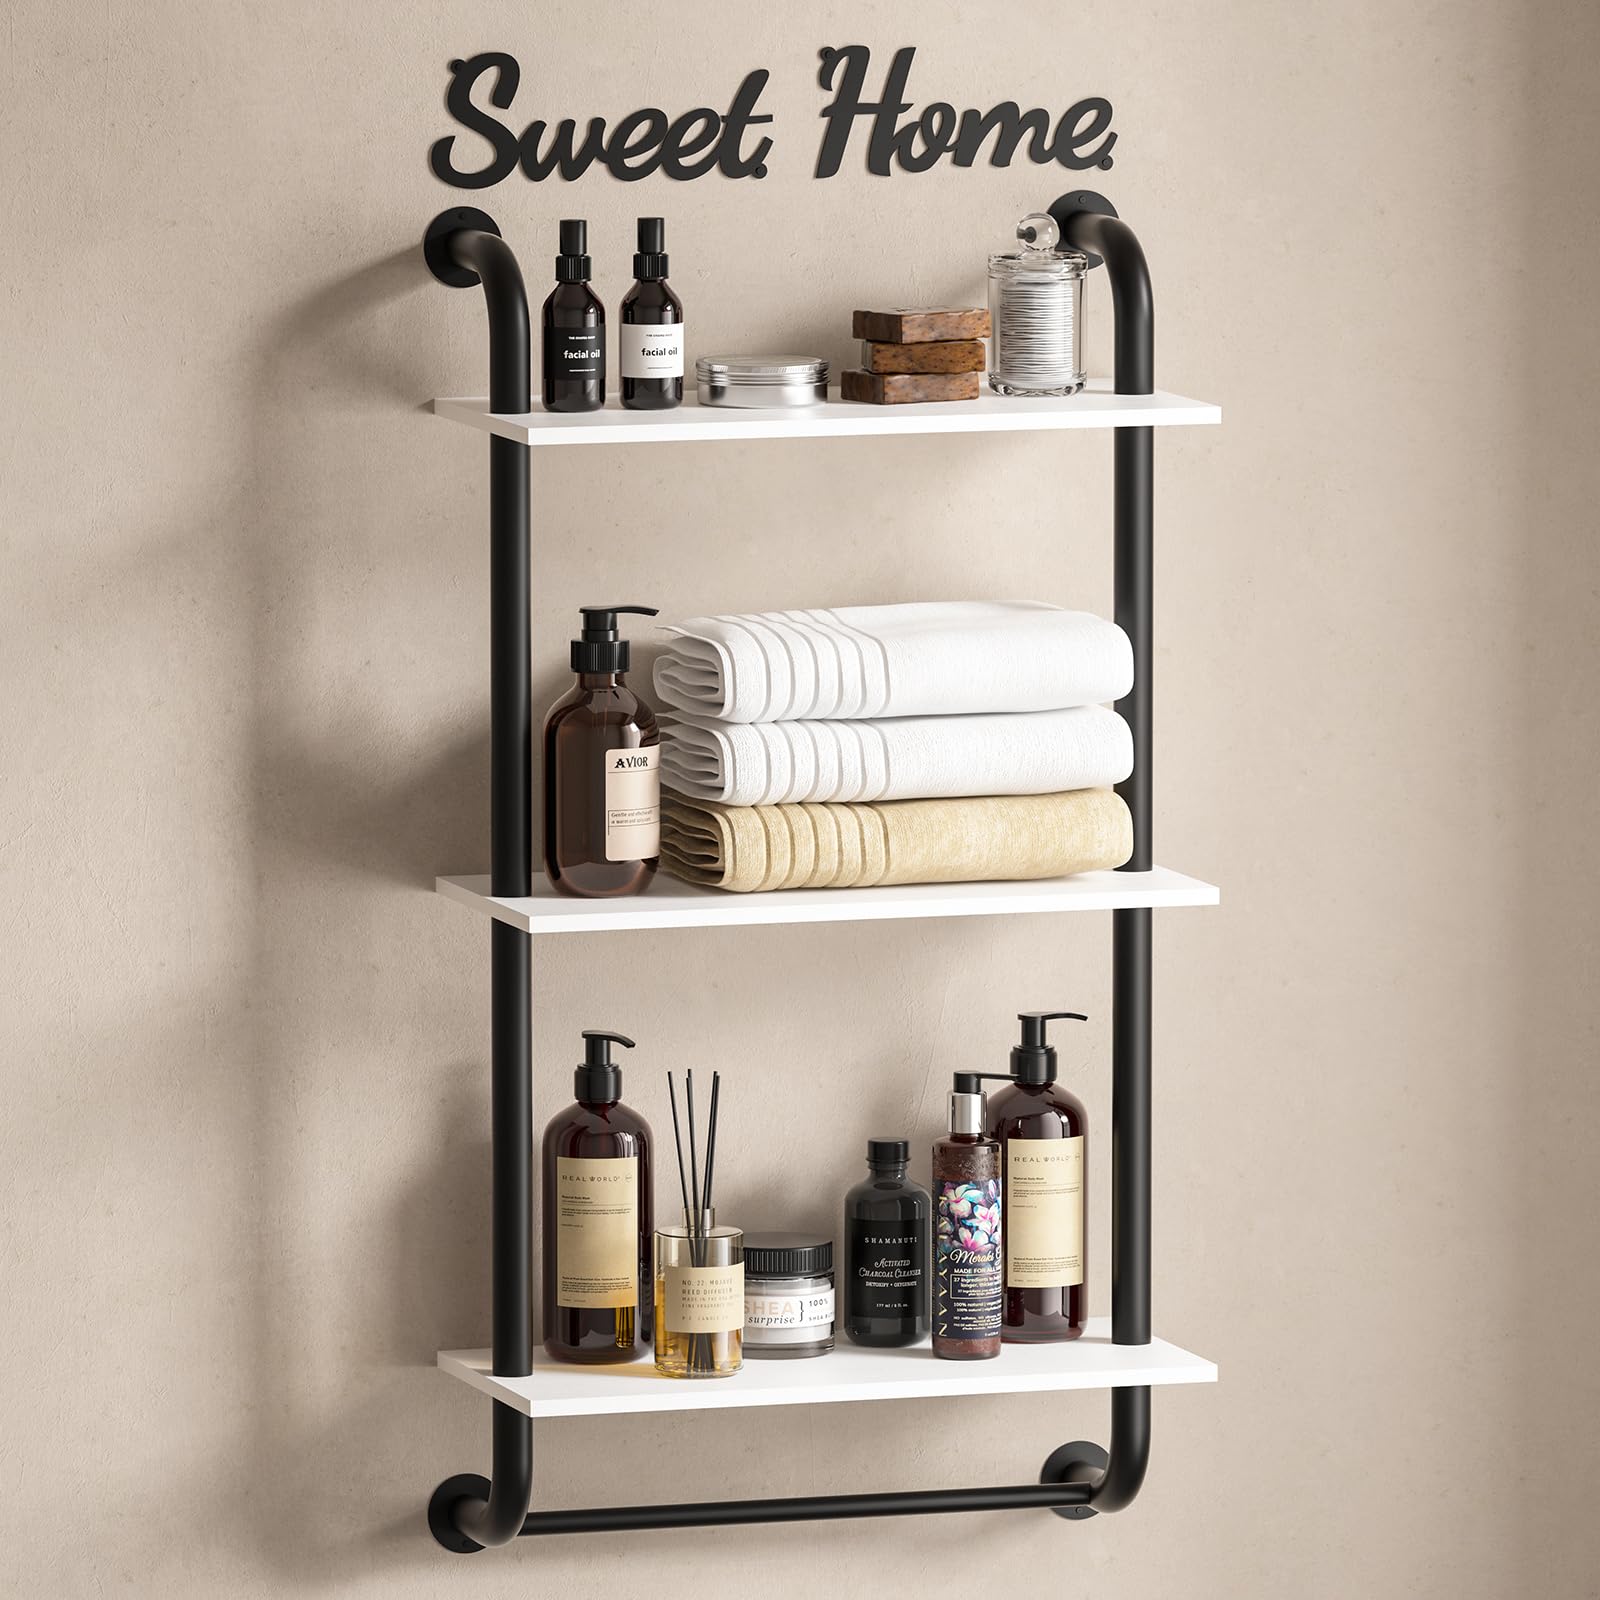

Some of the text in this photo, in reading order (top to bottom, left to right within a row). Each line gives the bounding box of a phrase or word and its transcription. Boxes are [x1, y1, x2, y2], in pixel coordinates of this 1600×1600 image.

[430, 45, 1118, 189] Sweet Home
[563, 349, 601, 359] facial oil
[641, 346, 678, 356] facial oil
[614, 756, 649, 769] AVIOR
[864, 1236, 917, 1244] SHAMANUTI
[950, 1248, 994, 1265] Meraki
[748, 1315, 795, 1326] surprise
